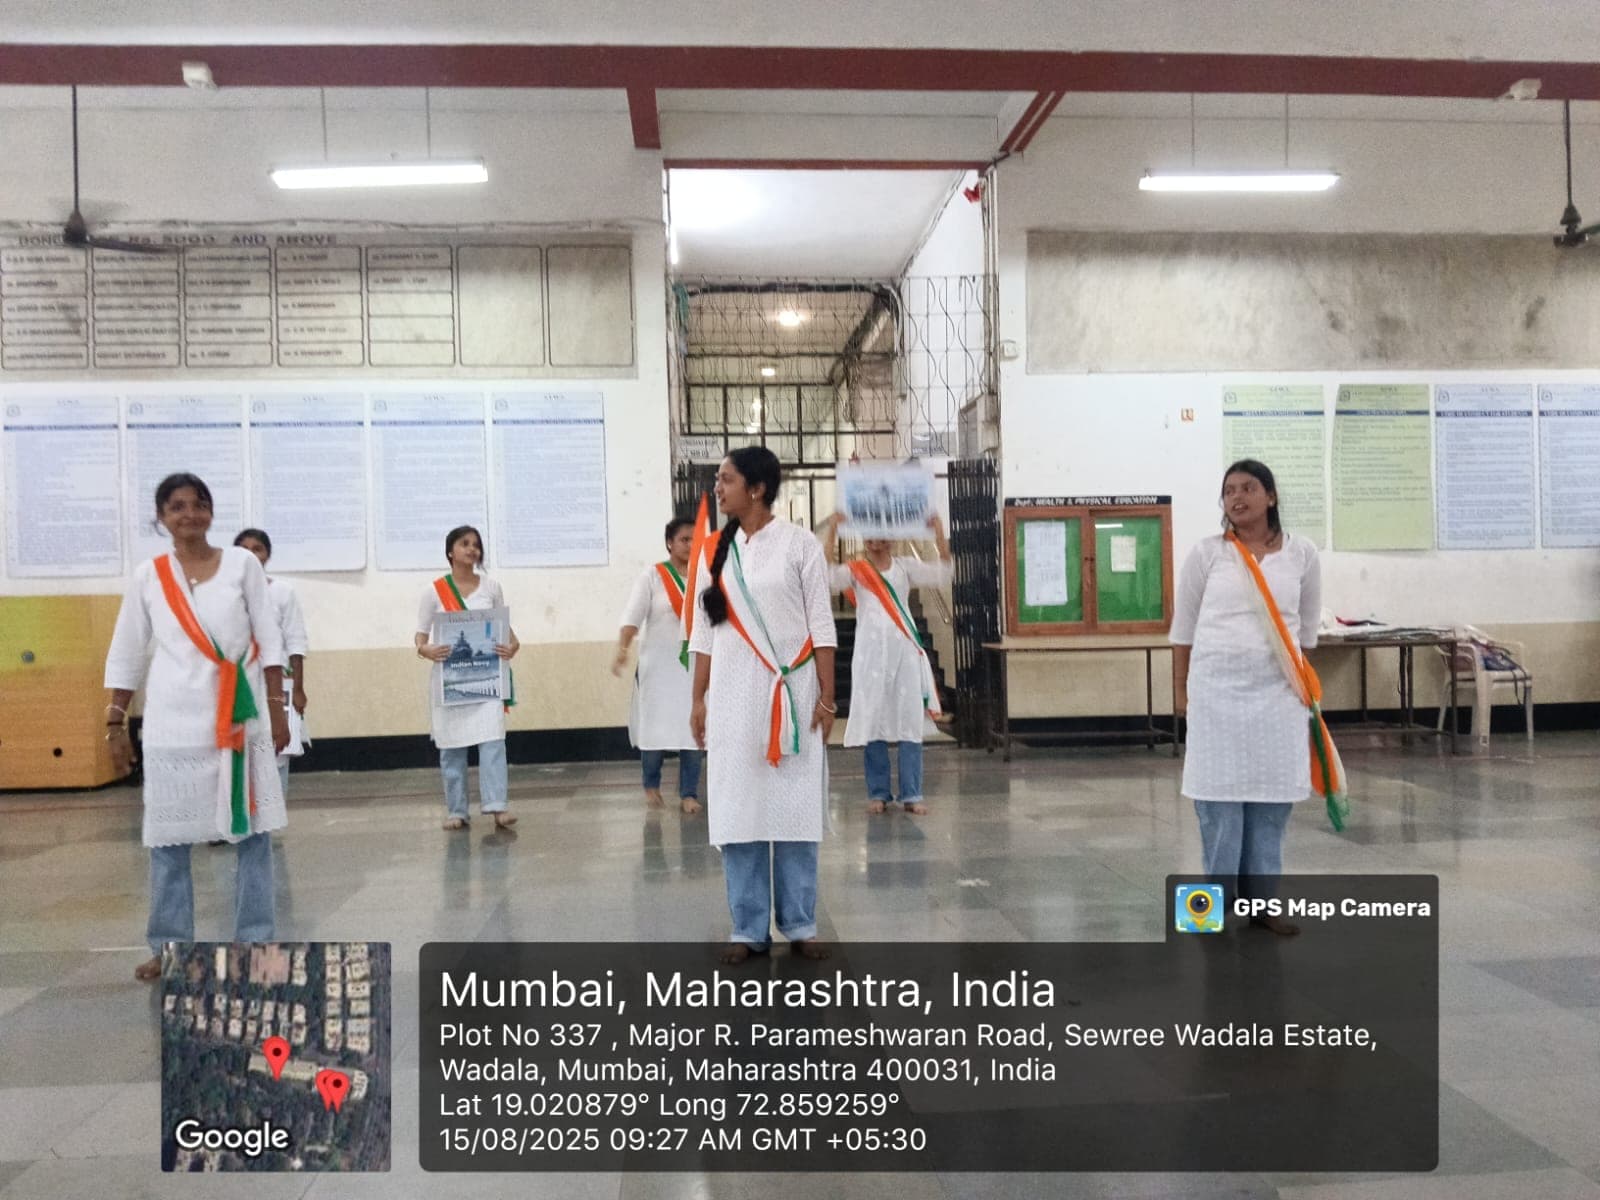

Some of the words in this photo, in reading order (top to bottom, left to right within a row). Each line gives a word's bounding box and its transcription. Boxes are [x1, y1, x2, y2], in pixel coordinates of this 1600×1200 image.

[230, 235, 266, 245] AND
[275, 234, 336, 245] ABOVE
[1035, 498, 1065, 506] HEALTH
[1067, 497, 1073, 505] &
[1075, 496, 1113, 505] PHYSICAL
[1115, 495, 1158, 505] EDUCATION
[450, 660, 472, 668] Indian
[473, 659, 490, 668] Navy
